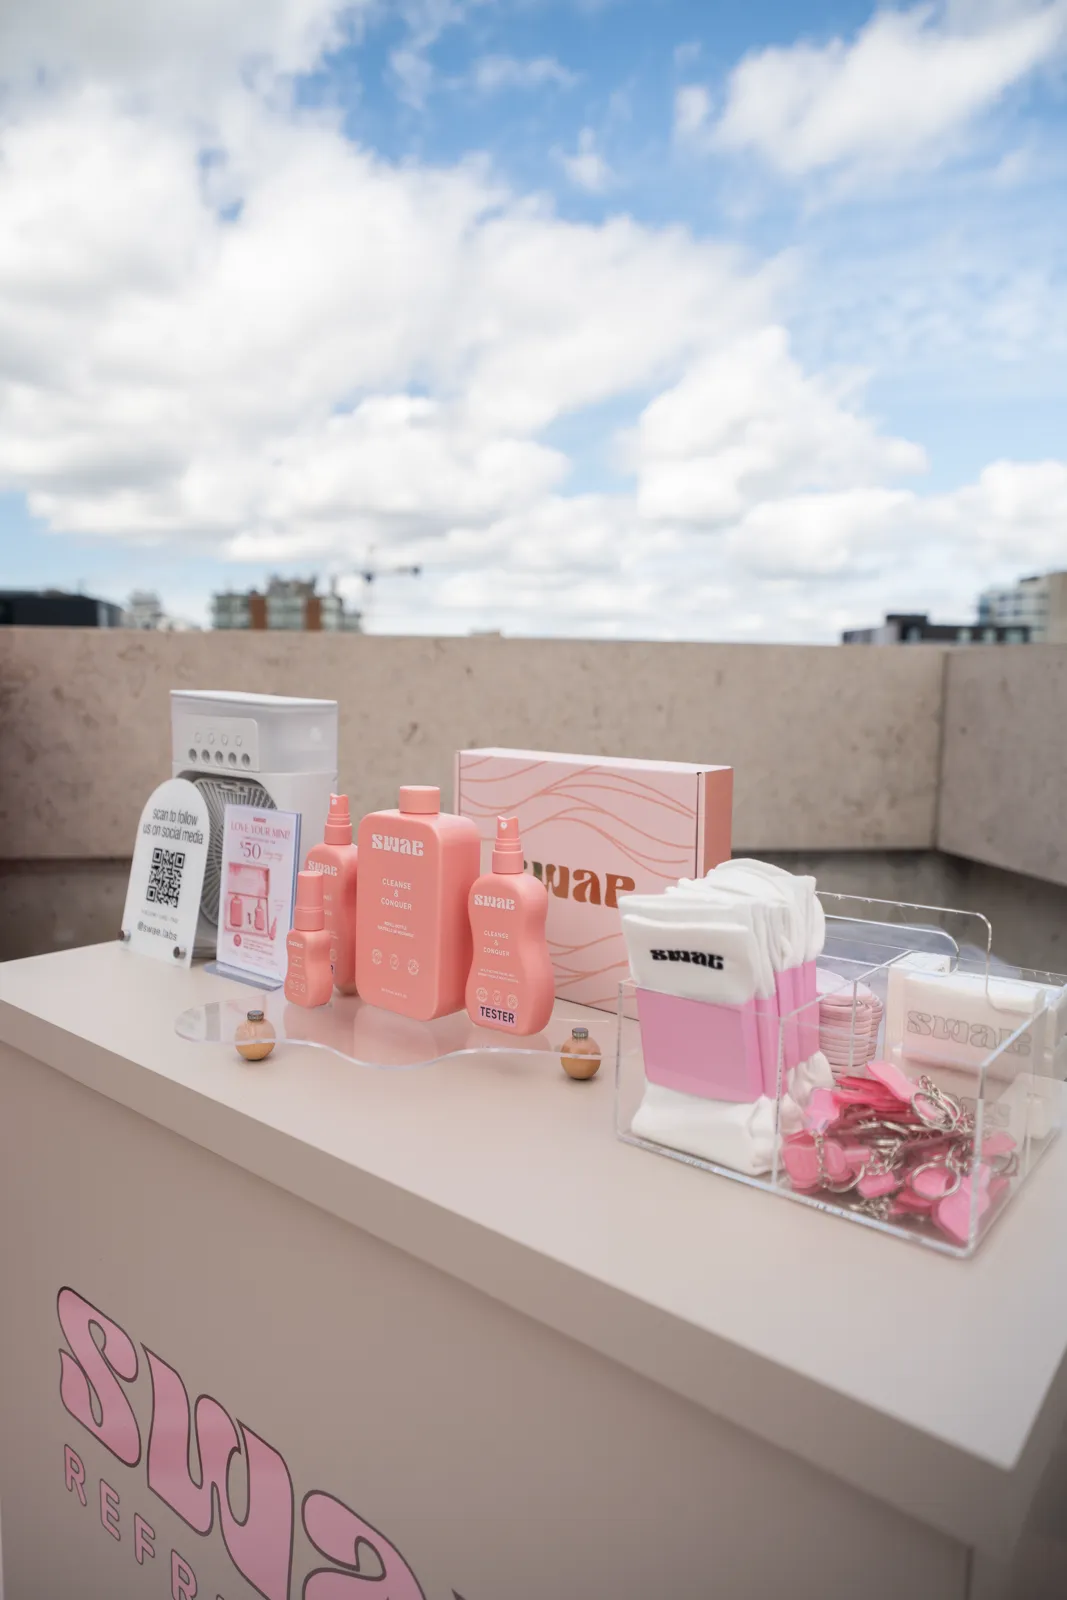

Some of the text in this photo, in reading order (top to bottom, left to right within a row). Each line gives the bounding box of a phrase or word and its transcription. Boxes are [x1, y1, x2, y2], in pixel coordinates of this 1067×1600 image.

[153, 808, 199, 826] scan to follow
[142, 823, 204, 845] us on social media
[231, 821, 249, 833] LOVE
[251, 824, 271, 837] YOUR
[240, 841, 262, 860] $50
[382, 878, 412, 891] CLEANSE
[393, 889, 399, 898] &
[380, 897, 412, 911] CONQUER
[483, 929, 509, 940] CLEANSE
[483, 947, 510, 957] CONQUER
[480, 1006, 515, 1024] TESTER
